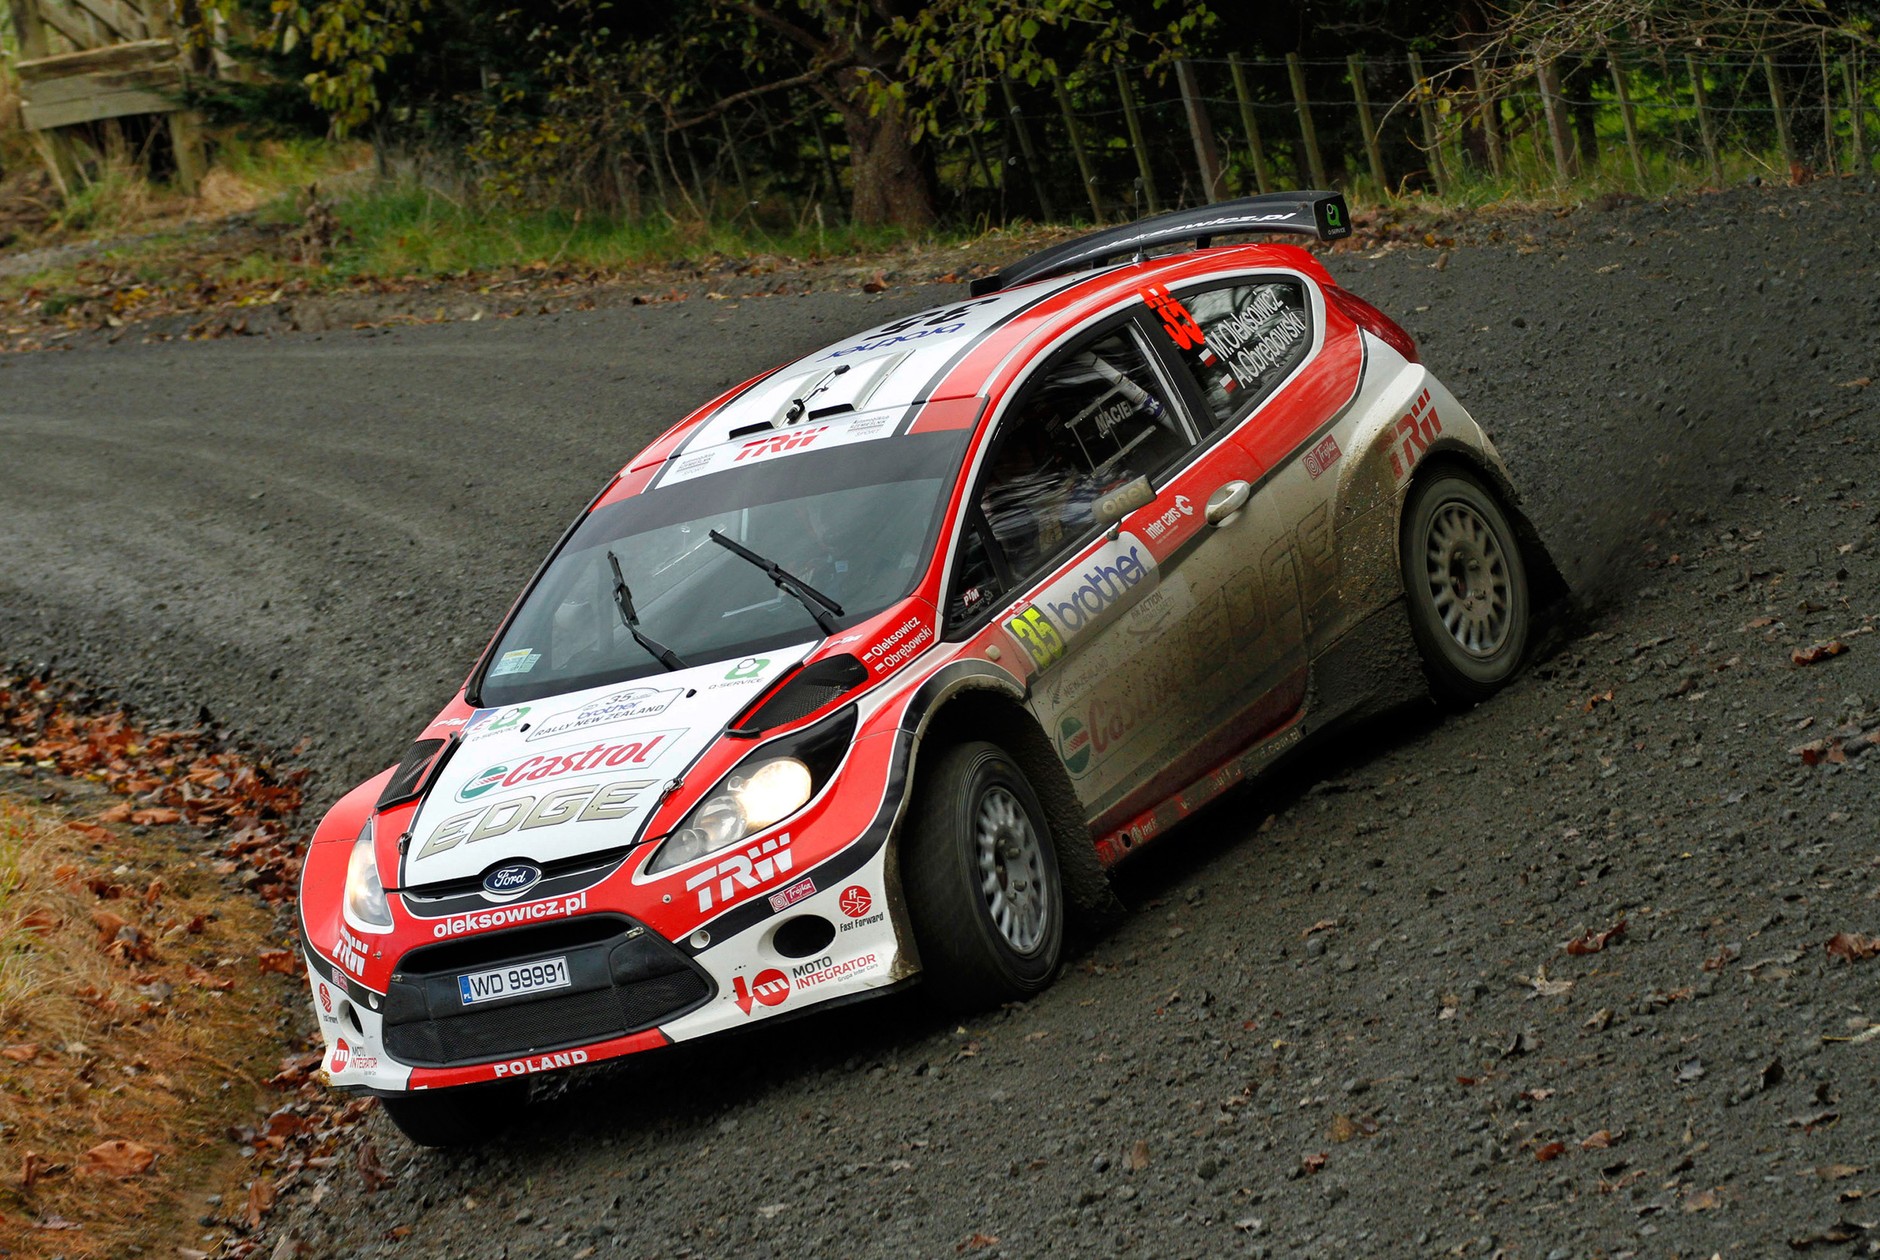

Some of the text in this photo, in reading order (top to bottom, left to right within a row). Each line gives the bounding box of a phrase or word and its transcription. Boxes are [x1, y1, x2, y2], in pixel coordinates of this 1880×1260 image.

[1137, 282, 1205, 350] 35
[734, 426, 829, 461] TRW
[1376, 388, 1443, 480] TRW
[1142, 520, 1166, 540] inter
[1161, 507, 1181, 526] cars
[963, 588, 980, 606] PTM
[1047, 545, 1148, 631] brother
[1139, 590, 1163, 614] ACTION
[871, 616, 921, 657] Oleksowicz
[884, 625, 934, 668] Obrębowski
[1010, 607, 1063, 669] 35
[577, 701, 642, 720] brother
[606, 692, 634, 705] 35
[535, 722, 574, 737] RALLY
[574, 716, 604, 728] NEW
[605, 705, 665, 720] ZEALAND
[501, 734, 665, 787] Castrol
[416, 779, 659, 861] EDGE
[494, 870, 526, 887] Ford
[686, 833, 793, 913] TRW
[433, 892, 587, 938] oleksowicz.pl
[840, 912, 884, 932] Fast Forward
[471, 962, 566, 997] WD 99991
[792, 956, 832, 978] MOTO
[796, 954, 876, 990] INTEGRATOR
[838, 963, 878, 982] Grupa Inter Cars
[494, 1050, 587, 1077] POLAND
